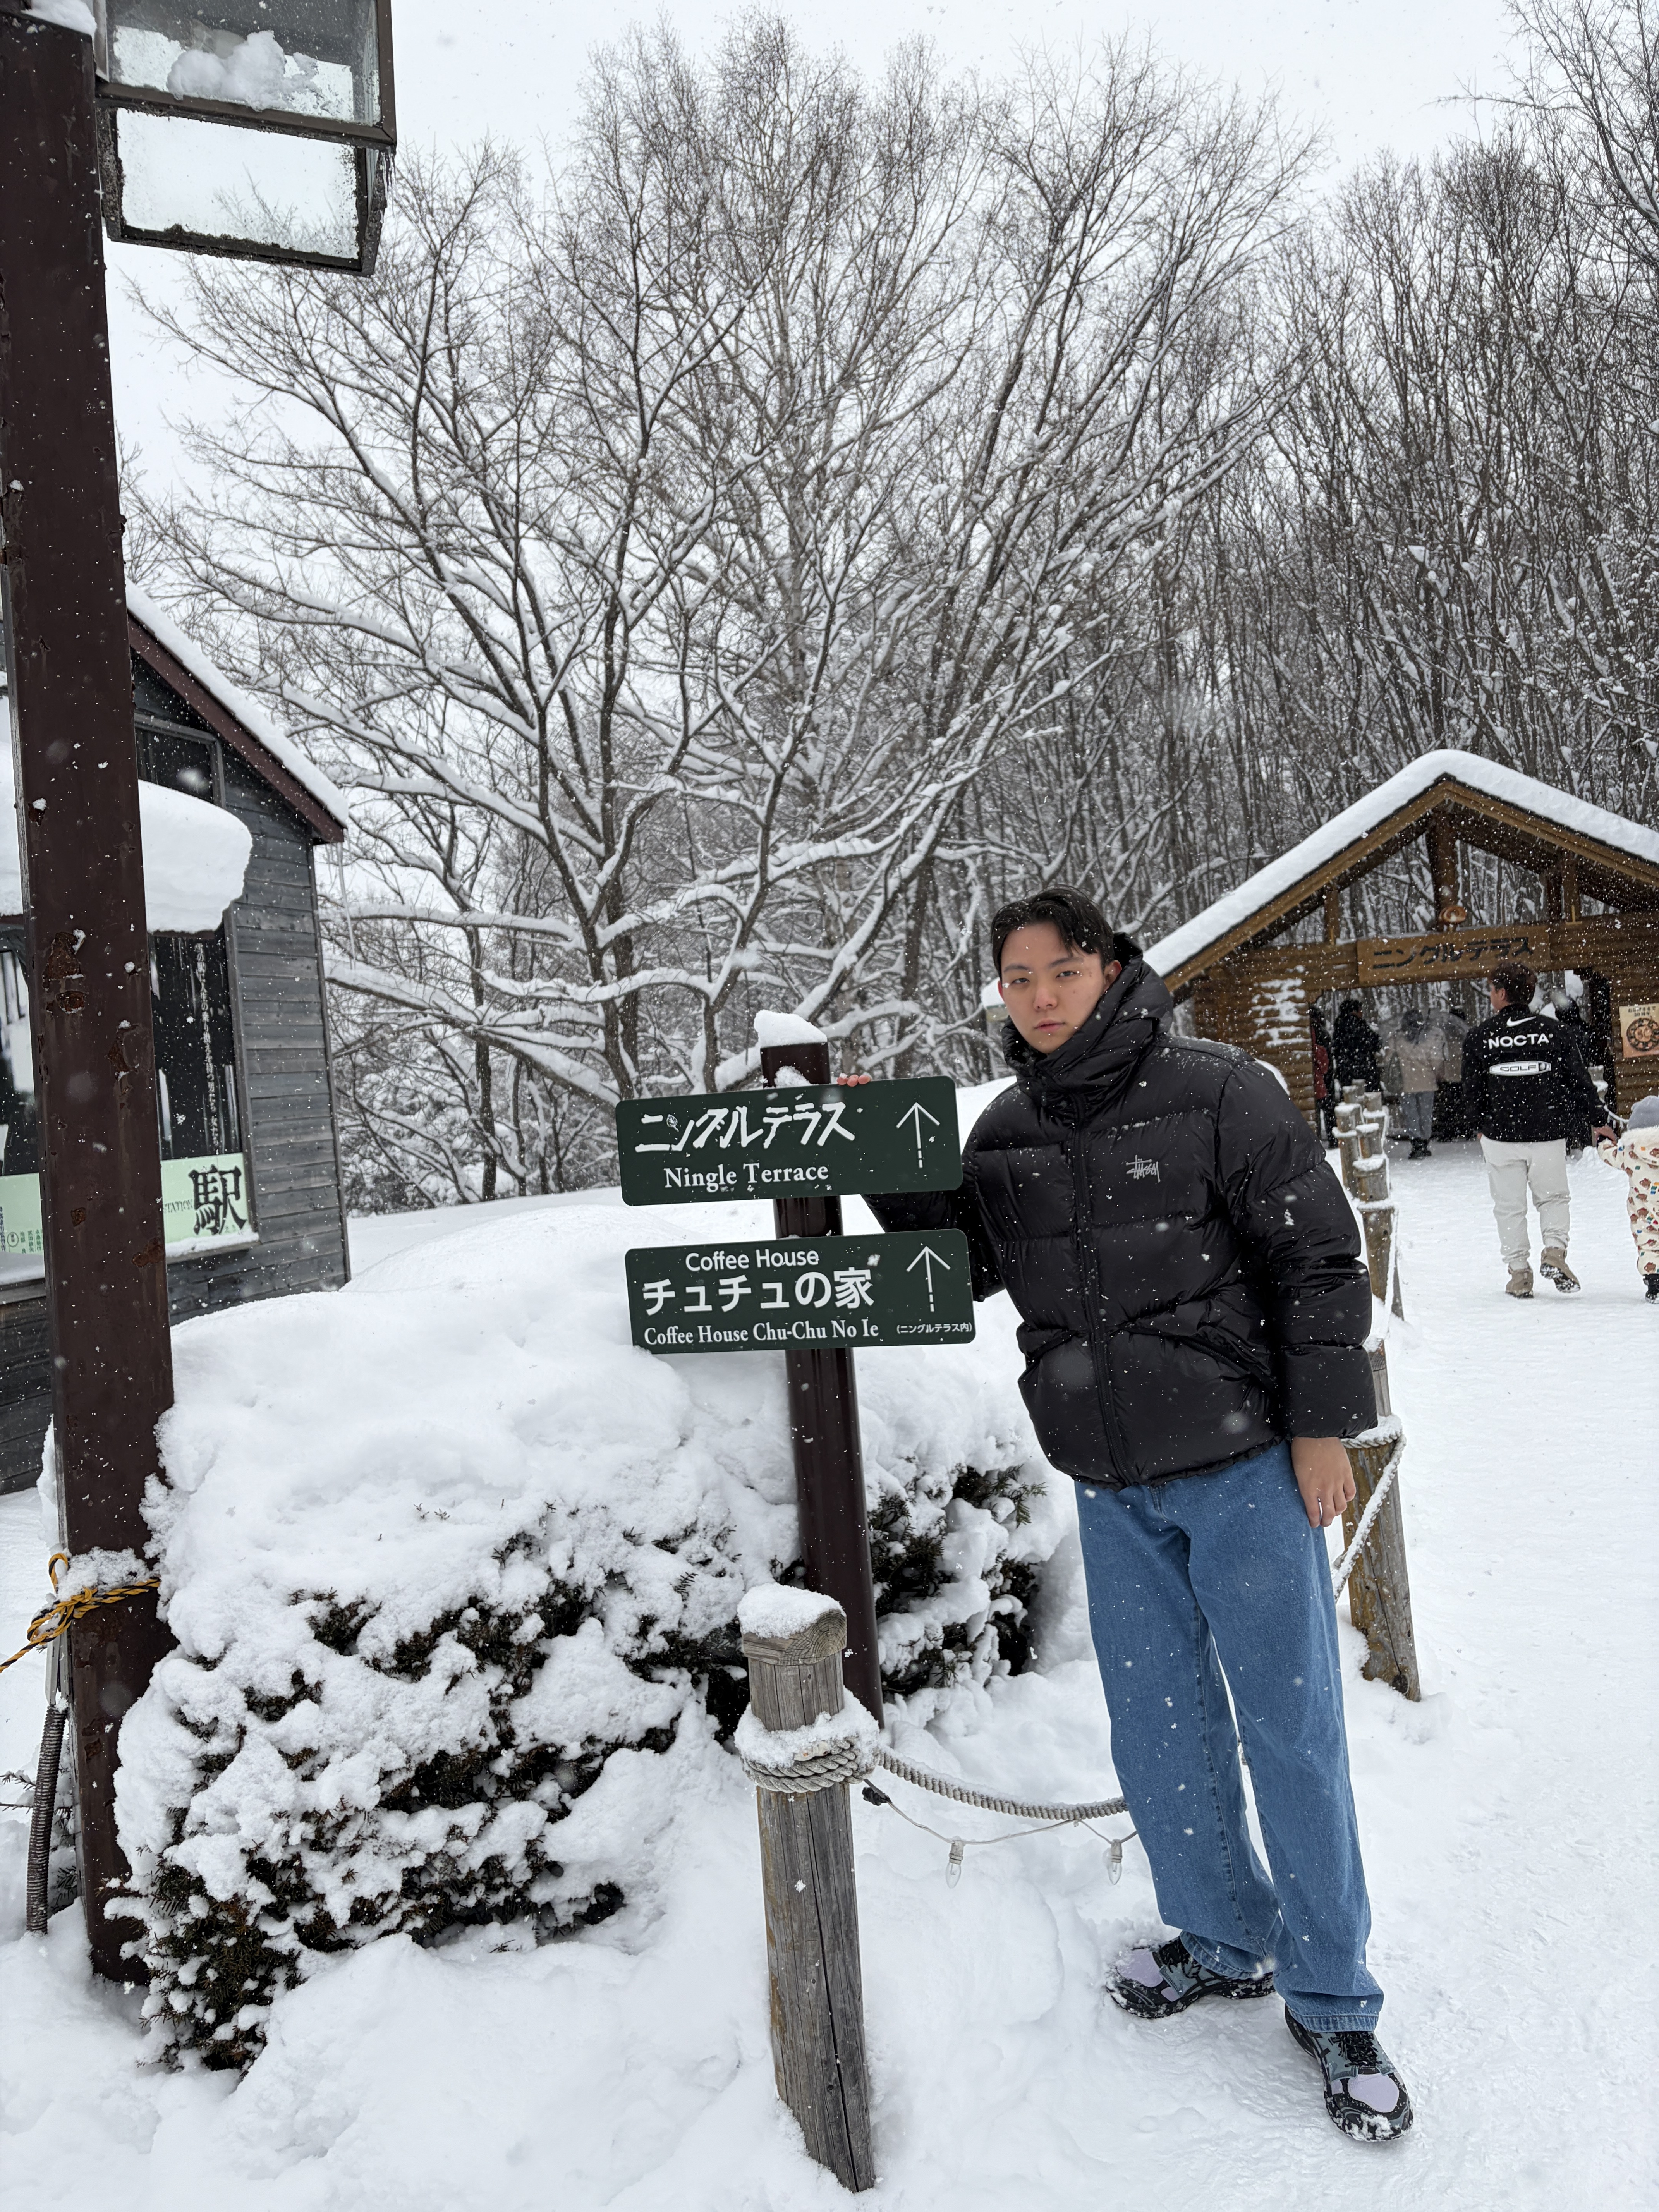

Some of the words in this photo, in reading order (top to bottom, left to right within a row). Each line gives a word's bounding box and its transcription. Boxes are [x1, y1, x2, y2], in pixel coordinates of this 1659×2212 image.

[1373, 936, 1533, 969] ニングルテラス
[1488, 1033, 1549, 1050] NOCTA
[635, 1101, 855, 1152] ニングルテラス
[663, 1164, 737, 1193] Ningle
[743, 1162, 829, 1184] Terrace
[188, 1164, 247, 1235] 駅
[685, 1250, 750, 1272] Coffee
[756, 1249, 820, 1268] House
[643, 1267, 874, 1316] チュチュの家
[644, 1325, 694, 1345] Coffee
[698, 1325, 749, 1343] House
[753, 1320, 828, 1341] Chu-Chu
[830, 1319, 857, 1338] No
[861, 1319, 879, 1337] Ie
[896, 1322, 972, 1334] (ニングルテラス内)
